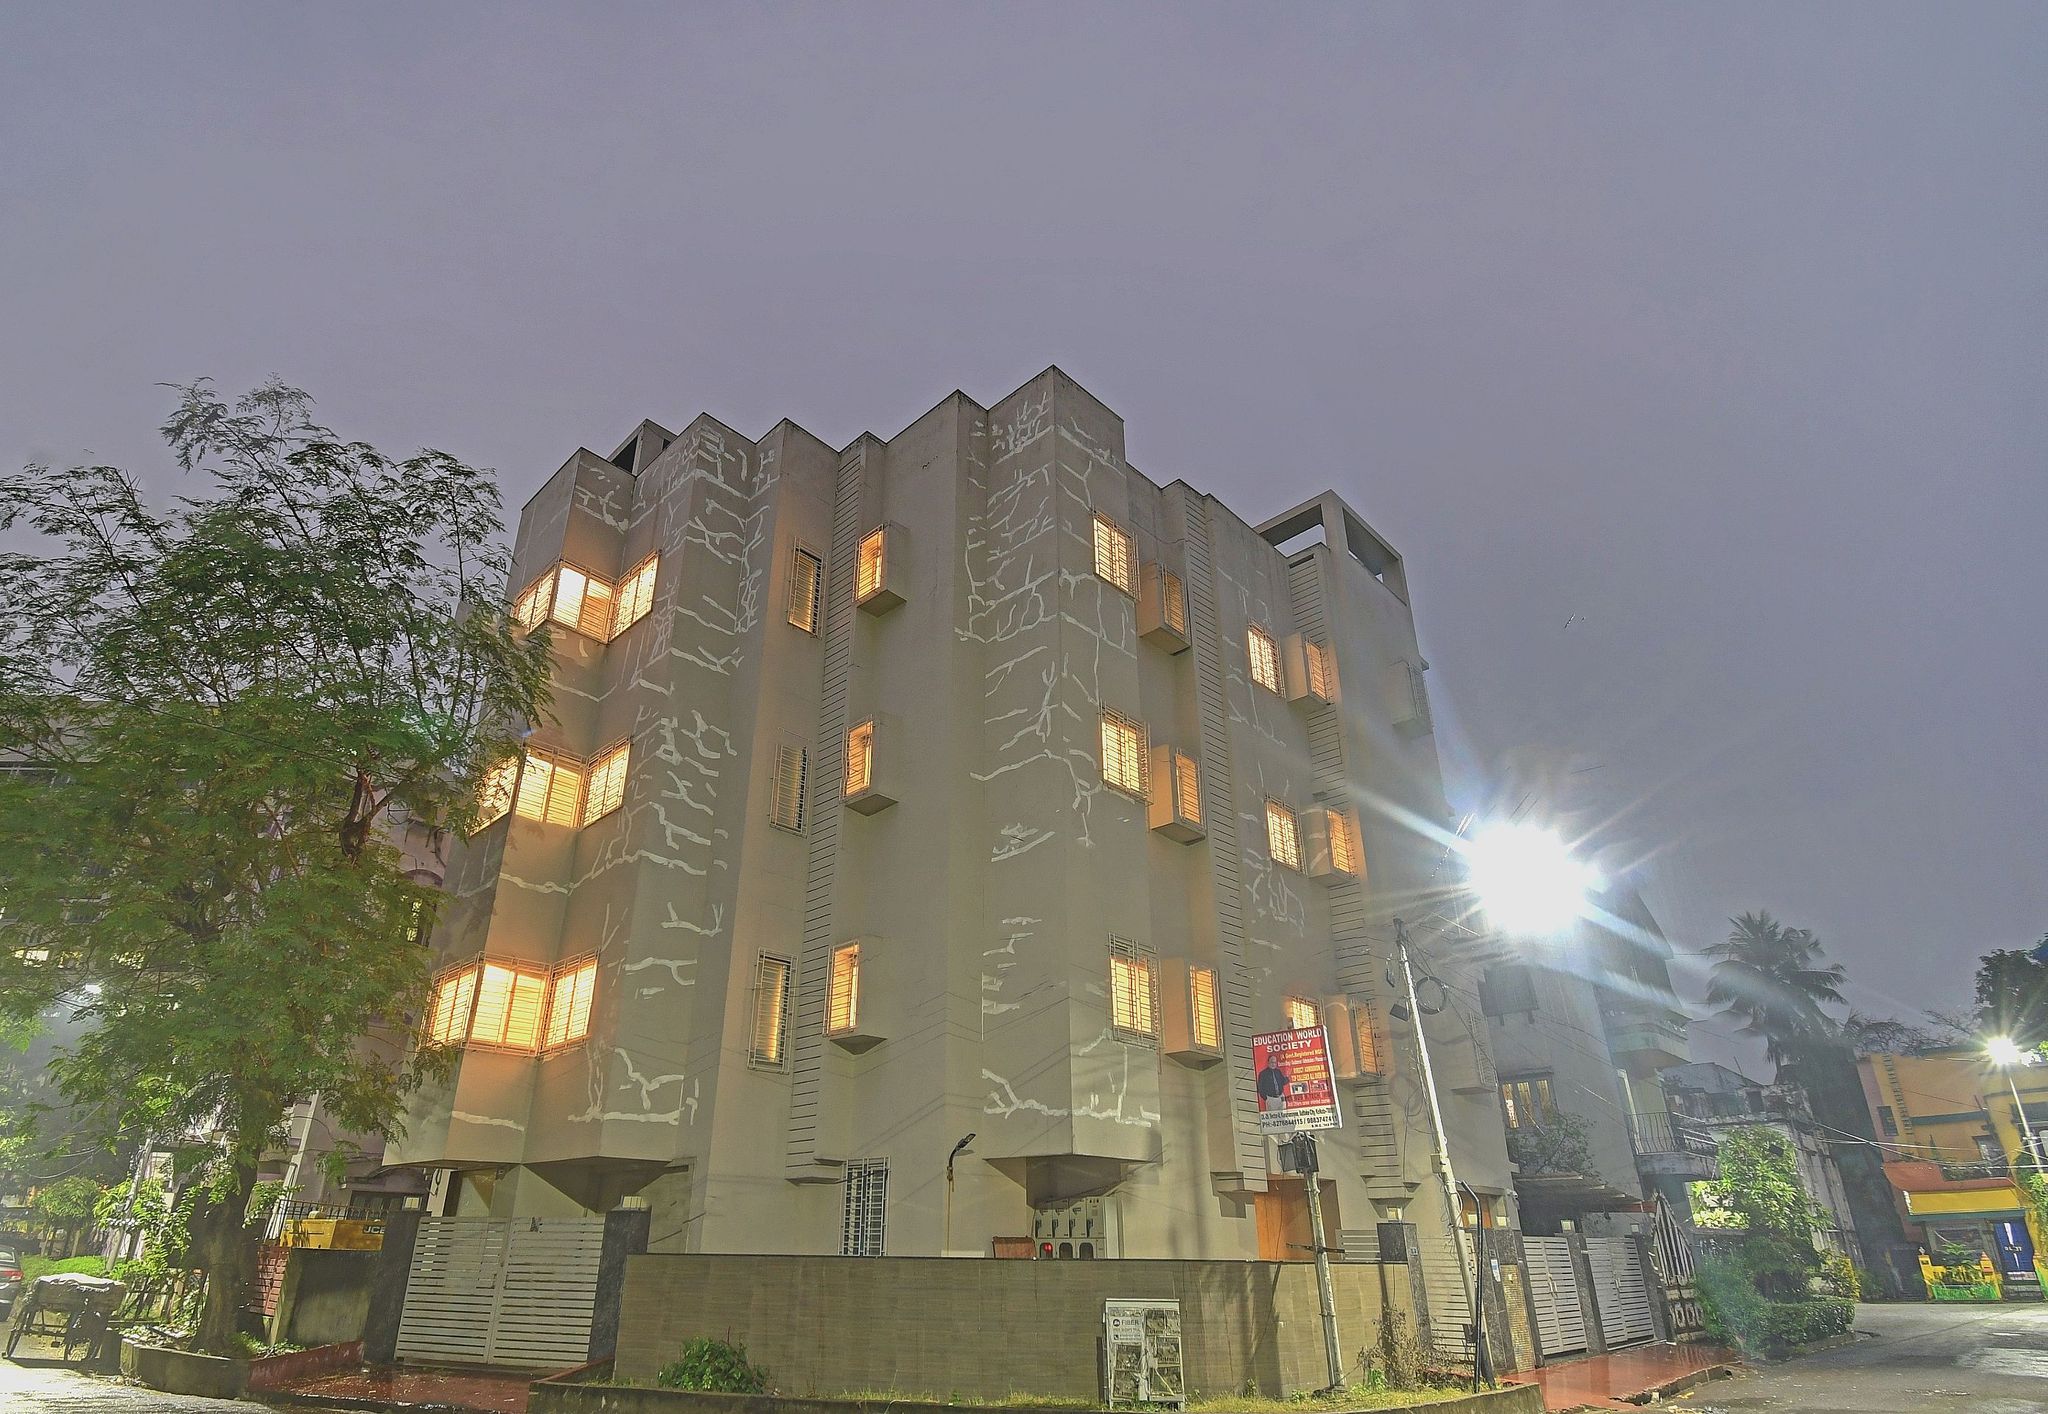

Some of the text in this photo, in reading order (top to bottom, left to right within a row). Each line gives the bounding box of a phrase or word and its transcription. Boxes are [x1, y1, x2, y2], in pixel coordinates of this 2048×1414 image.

[1253, 1028, 1322, 1046] EDUCATION WORLD
[1266, 1040, 1312, 1053] SOCIETY
